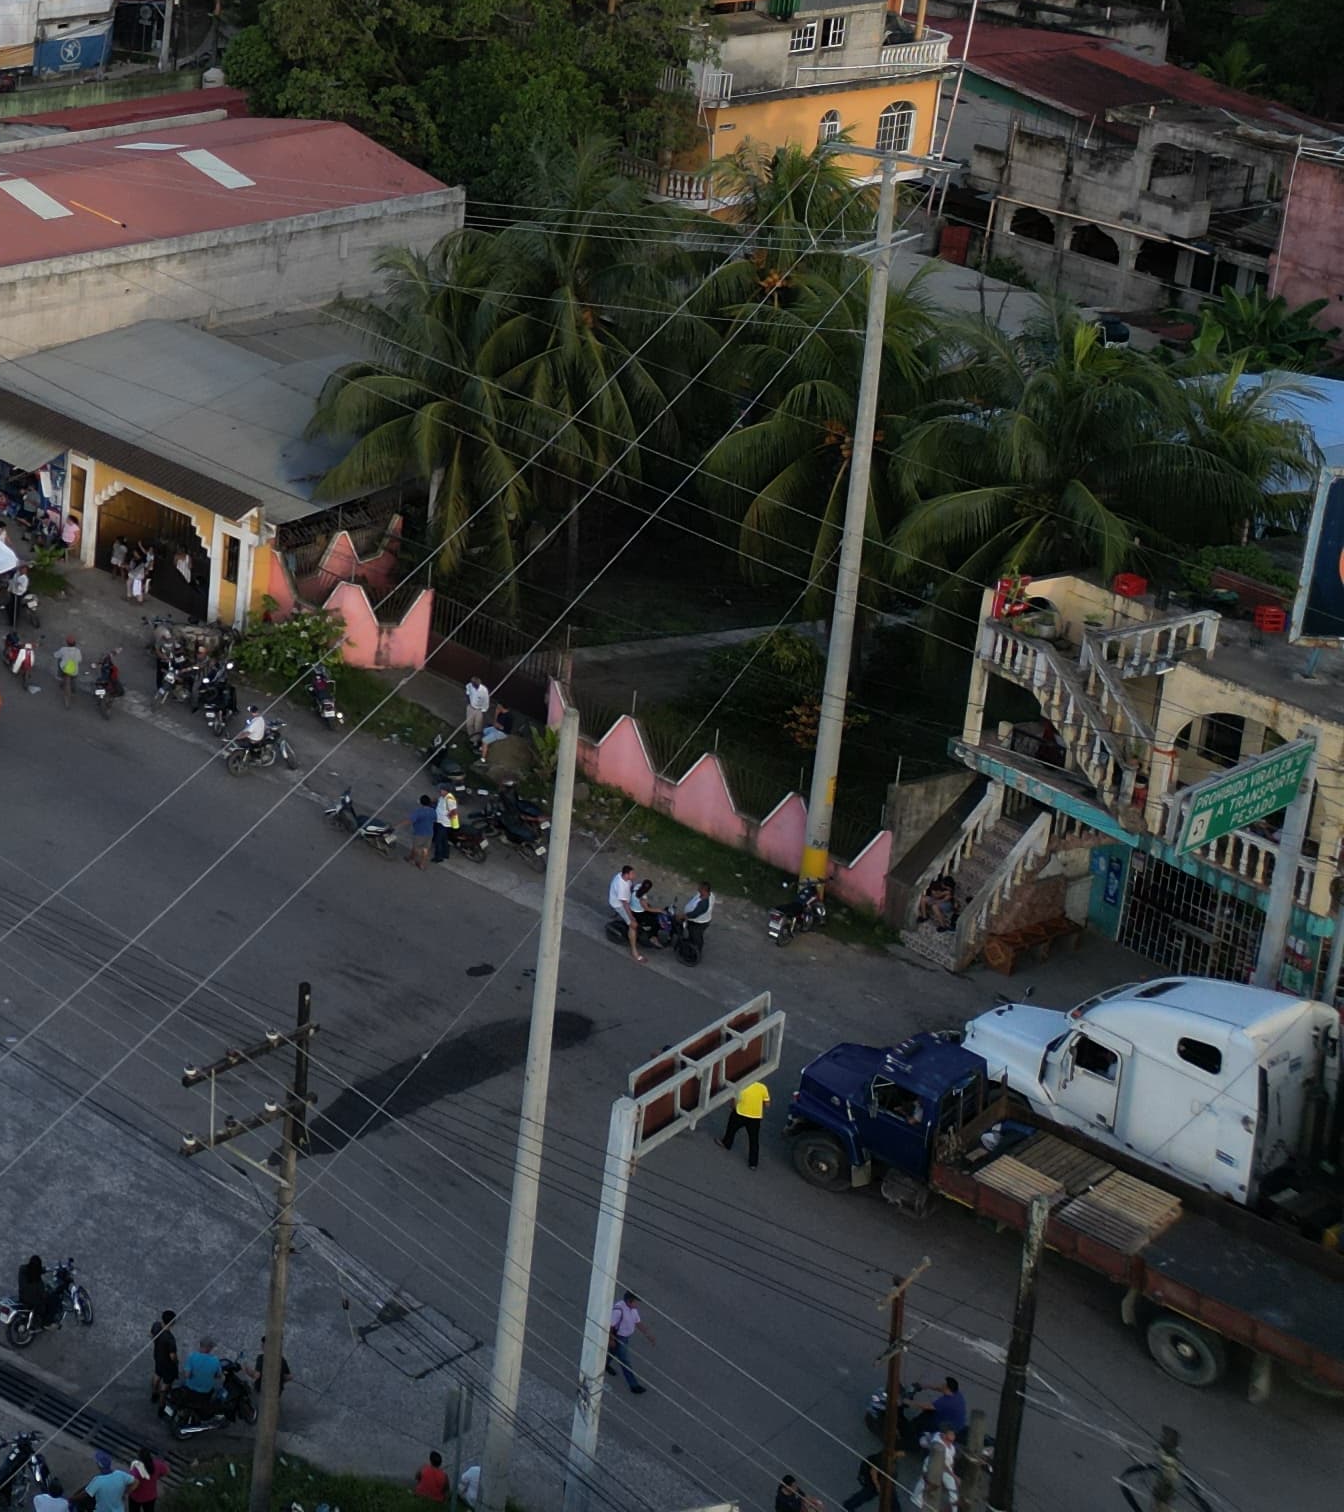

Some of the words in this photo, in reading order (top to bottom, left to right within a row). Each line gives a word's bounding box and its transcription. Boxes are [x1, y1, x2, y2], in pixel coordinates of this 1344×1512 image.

[1194, 777, 1248, 811] PROHIBIDO
[1251, 762, 1280, 788] VIRAR
[1215, 802, 1224, 819] A
[1229, 769, 1300, 812] TRANSPORTE
[1229, 794, 1277, 827] PESADO
